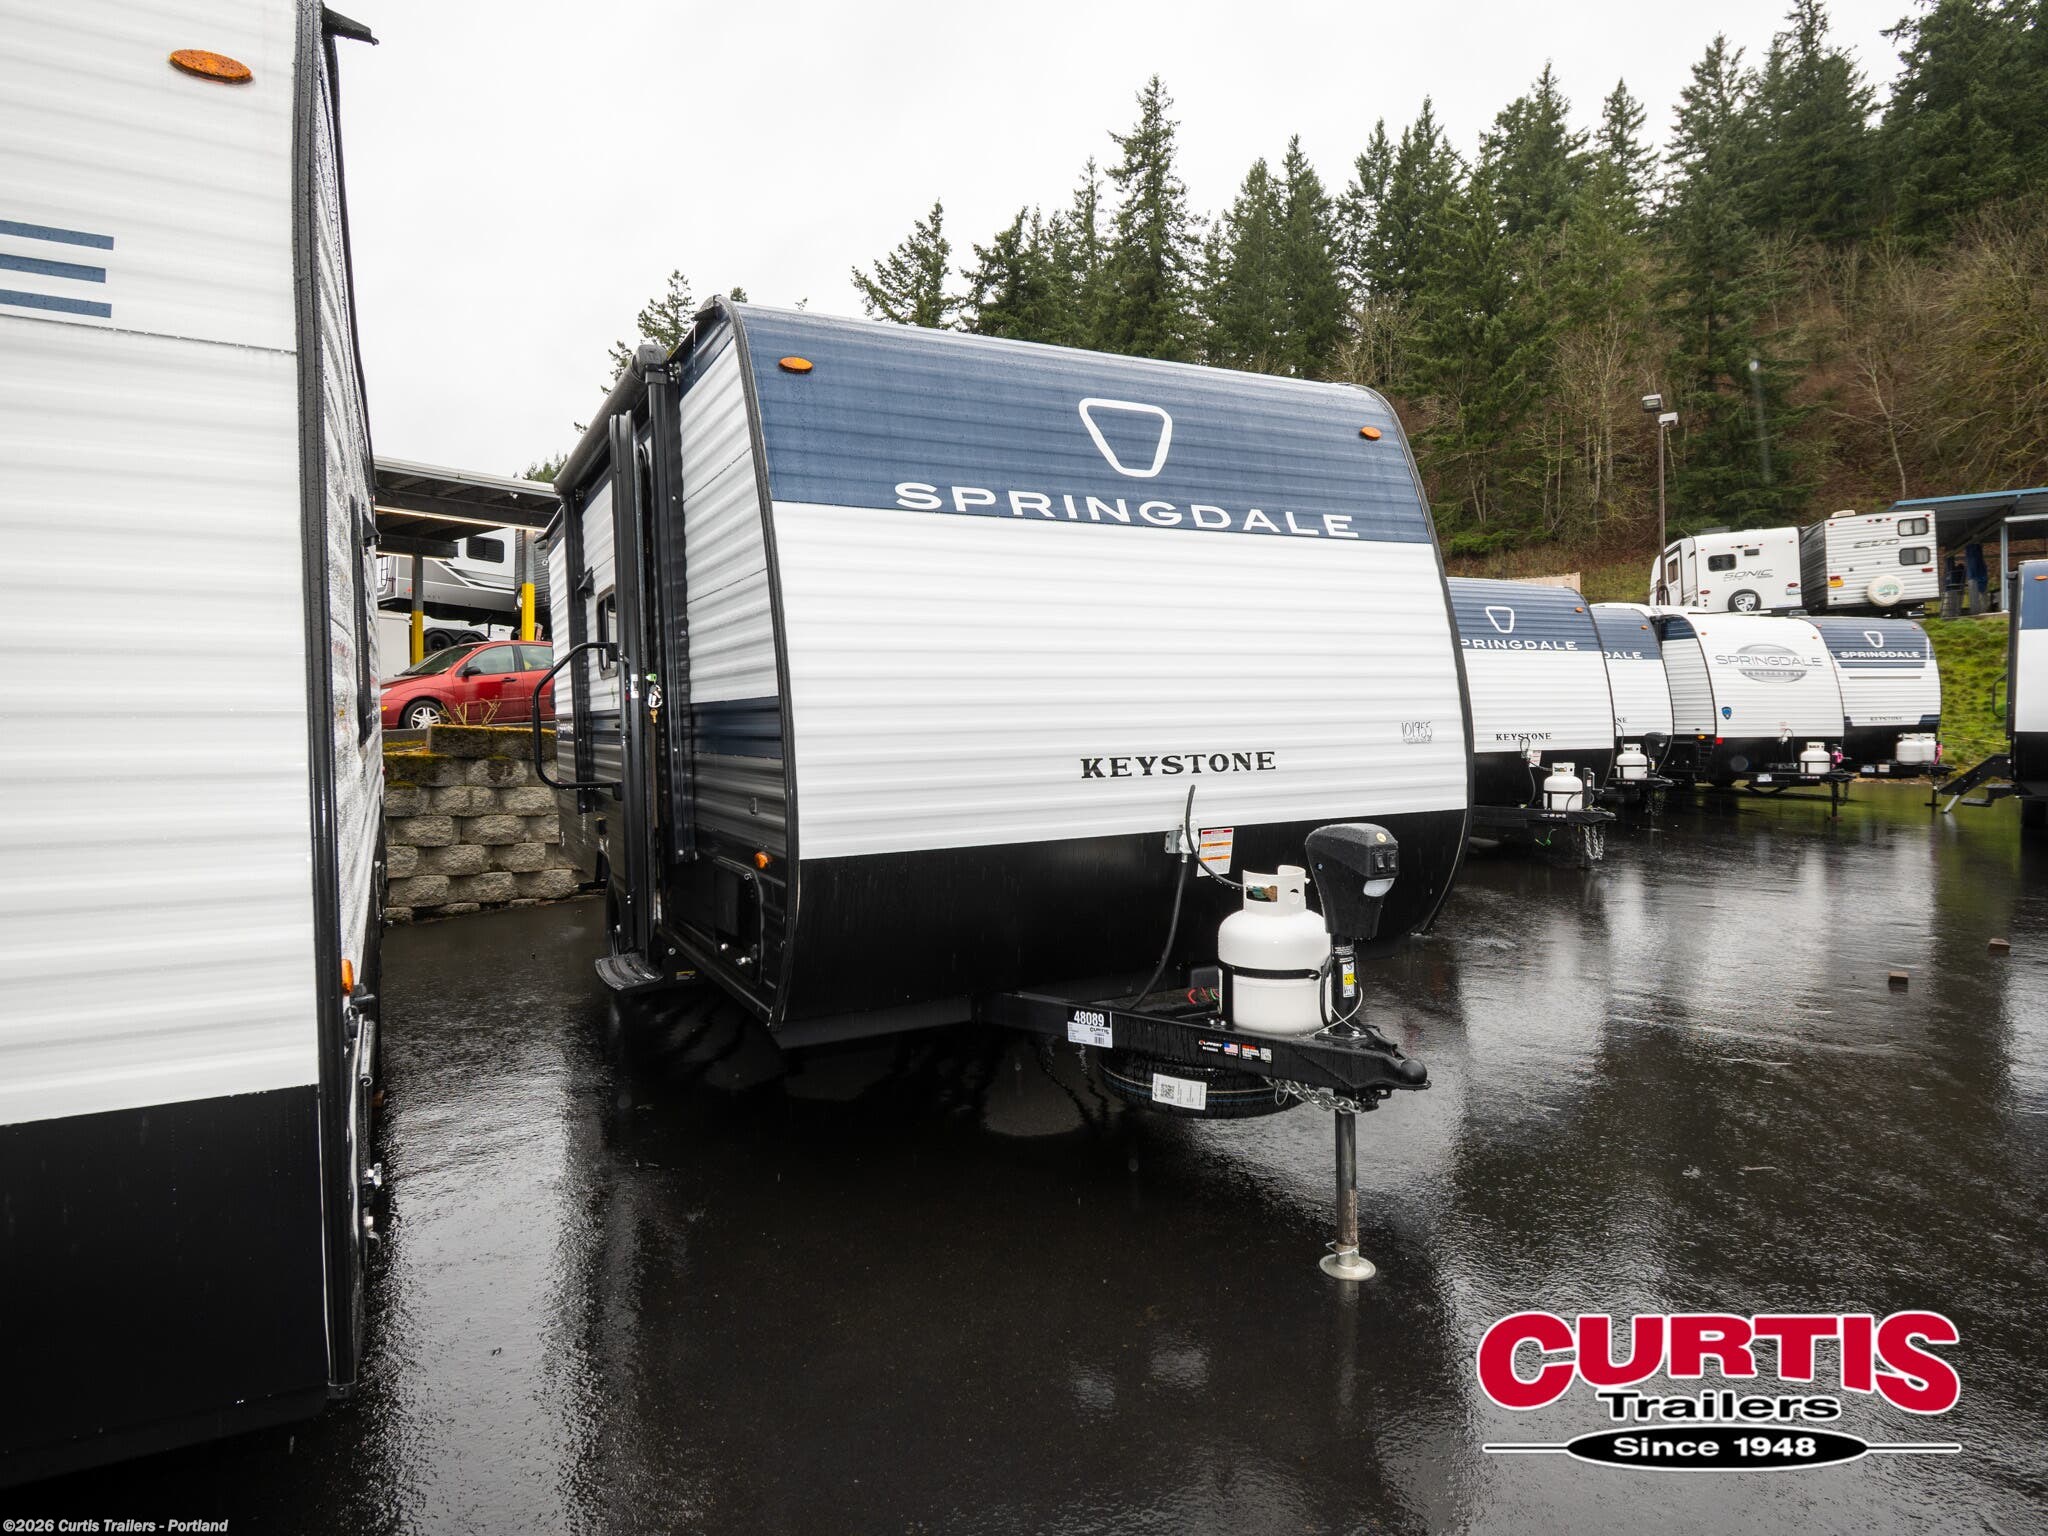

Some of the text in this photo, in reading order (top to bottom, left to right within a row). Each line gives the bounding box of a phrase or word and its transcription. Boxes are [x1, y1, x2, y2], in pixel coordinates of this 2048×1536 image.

[894, 482, 1359, 538] SPRINGDALE
[1723, 569, 1773, 579] SONIC
[1461, 639, 1578, 650] PRINGDALE
[1603, 651, 1643, 659] DALE
[1715, 655, 1824, 667] SPRINGDALE
[1496, 732, 1552, 741] KEYSTONE
[1080, 751, 1277, 779] KEYSTONE
[1073, 1010, 1105, 1027] 48089
